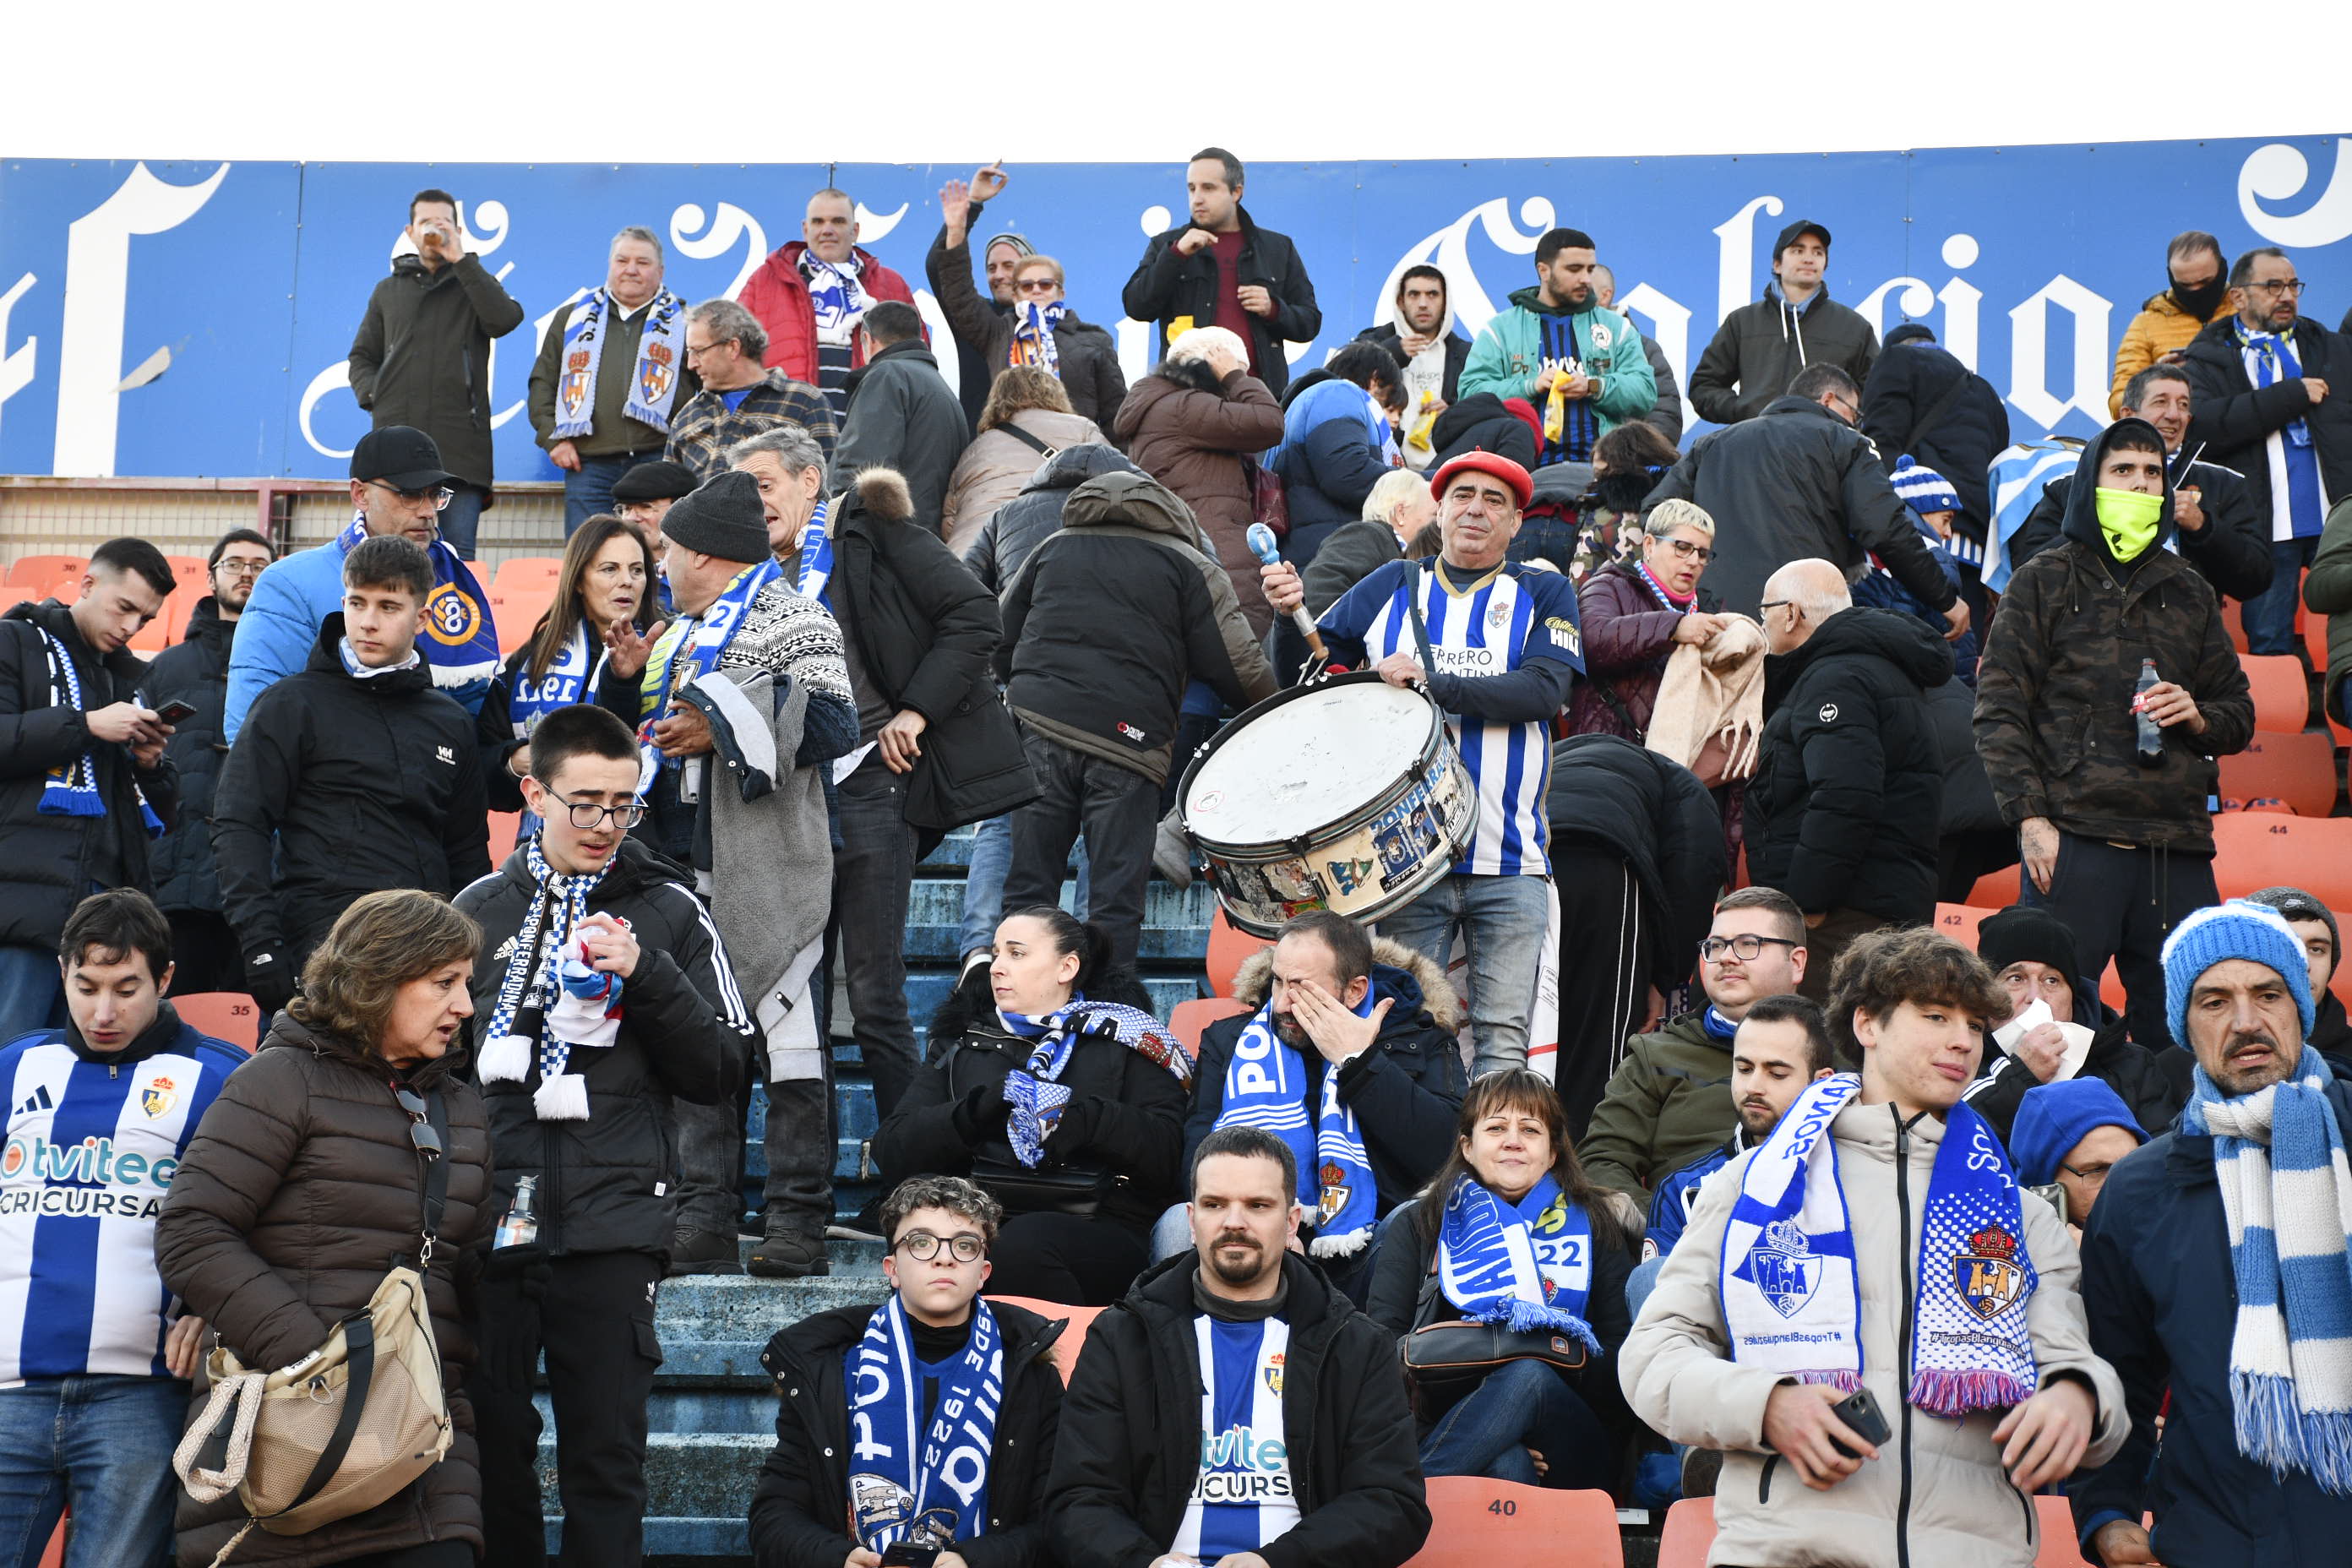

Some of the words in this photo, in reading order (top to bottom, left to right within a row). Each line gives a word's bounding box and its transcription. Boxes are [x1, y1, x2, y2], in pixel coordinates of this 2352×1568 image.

[2268, 825, 2288, 835] 44
[1943, 915, 1962, 926] 42
[231, 1005, 251, 1015] 35
[924, 1385, 971, 1467] 1922
[1487, 1499, 1517, 1516] 40
